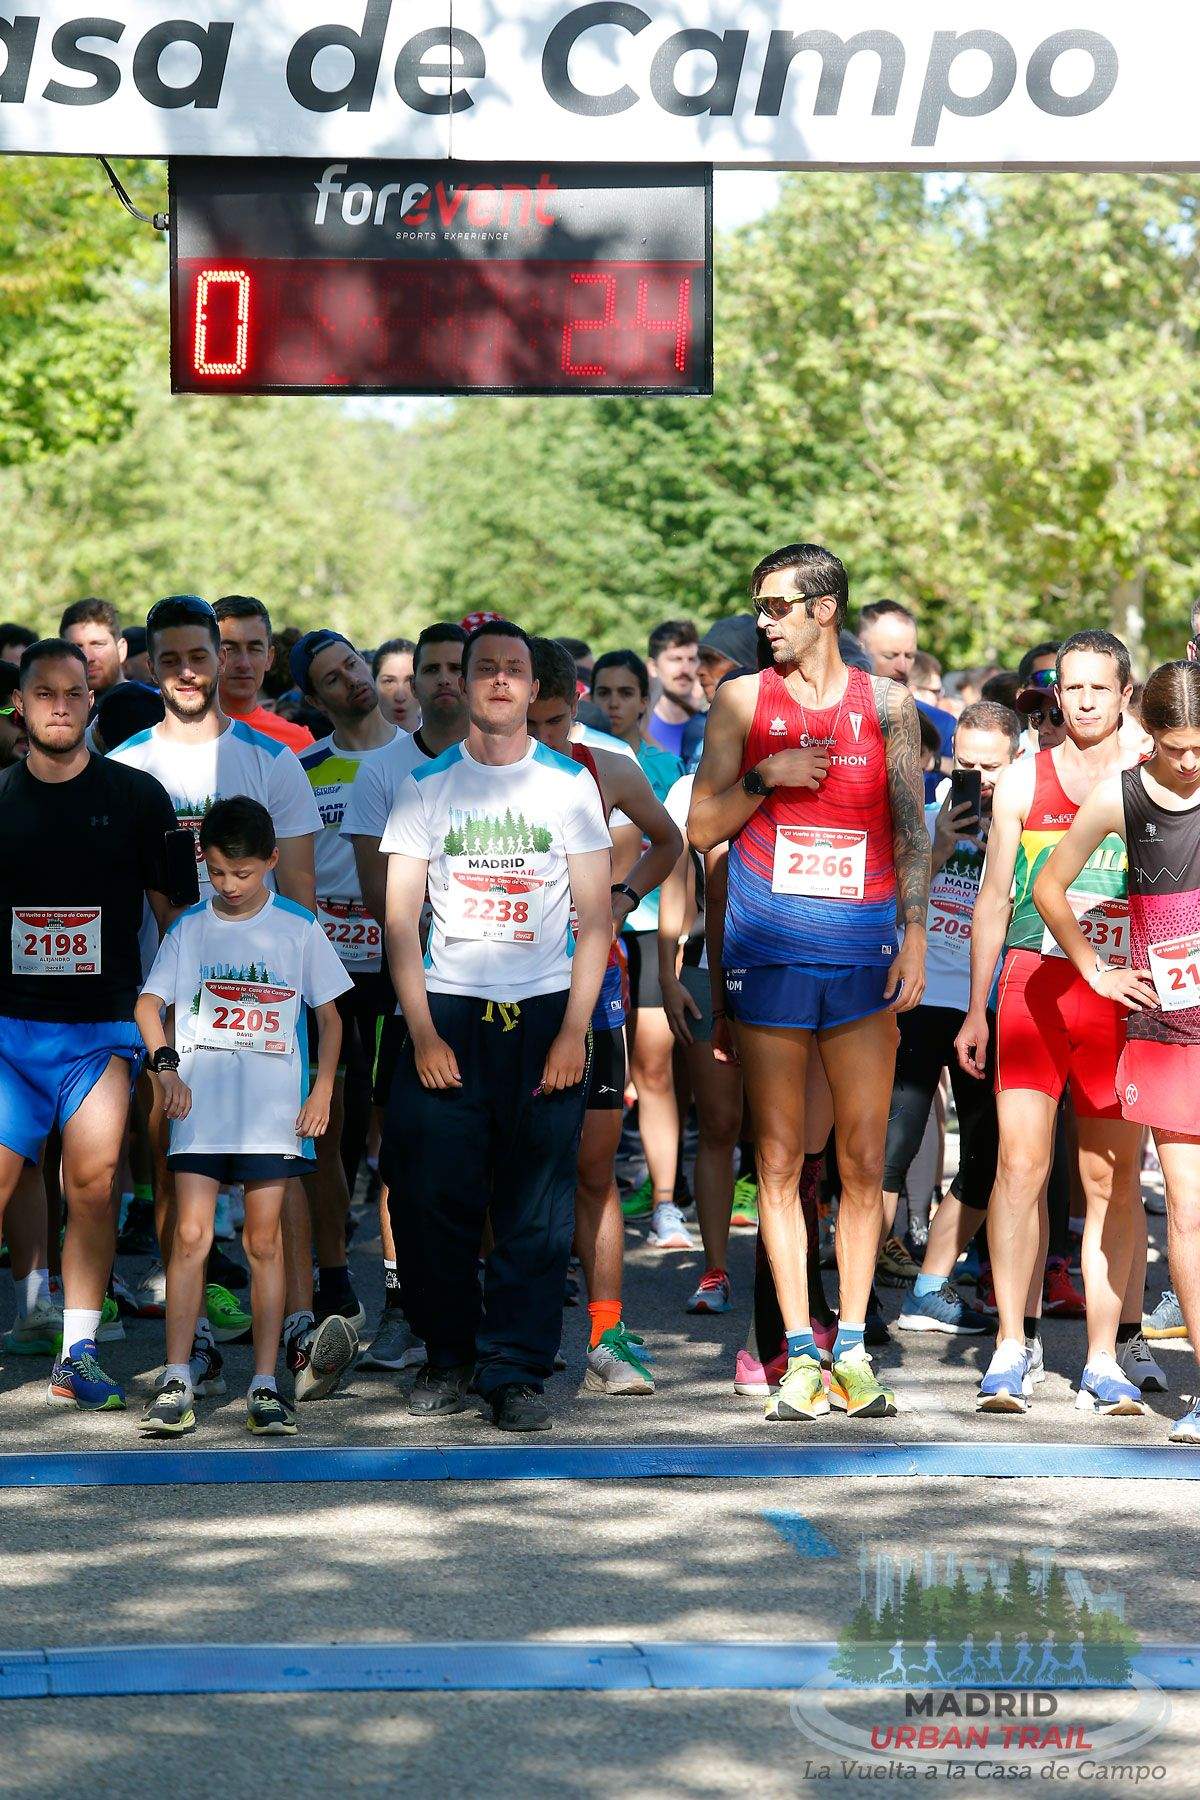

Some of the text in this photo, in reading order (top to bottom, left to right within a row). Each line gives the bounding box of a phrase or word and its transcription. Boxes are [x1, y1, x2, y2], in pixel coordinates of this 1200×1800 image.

[286, 0, 486, 115] de
[541, 1, 1119, 146] Campo
[313, 164, 559, 226] forevent
[396, 232, 510, 241] SPORTS EXPERIENCE
[194, 270, 691, 376] 0 24
[830, 756, 867, 766] THON
[468, 858, 525, 869] MADRID
[788, 852, 853, 877] 2266
[932, 886, 970, 898] URBAN
[944, 877, 979, 893] MADR
[463, 898, 529, 923] 2238
[323, 922, 380, 946] 2228
[929, 916, 972, 940] 209
[1078, 920, 1124, 948] 231
[24, 933, 88, 956] 2198
[1167, 963, 1200, 991] 21
[212, 1006, 280, 1033] 2205
[182, 1046, 192, 1054] La
